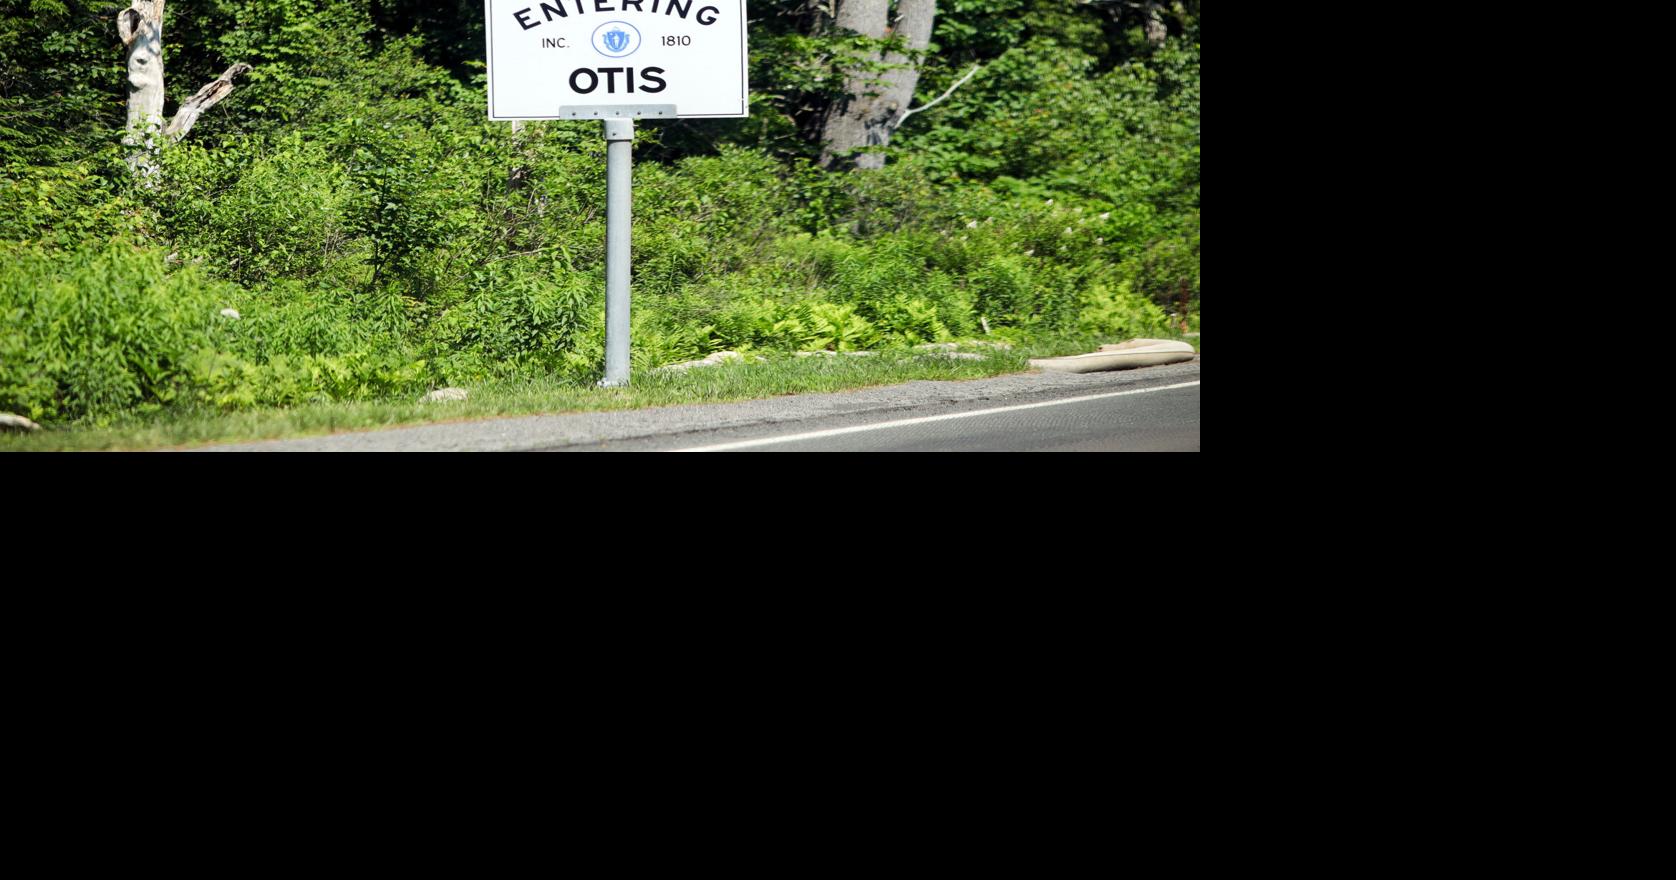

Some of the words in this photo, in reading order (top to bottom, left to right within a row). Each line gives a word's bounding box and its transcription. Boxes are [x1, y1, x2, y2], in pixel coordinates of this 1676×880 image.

[541, 37, 571, 49] INC.
[661, 35, 692, 47] 1810
[568, 66, 667, 95] OTIS
